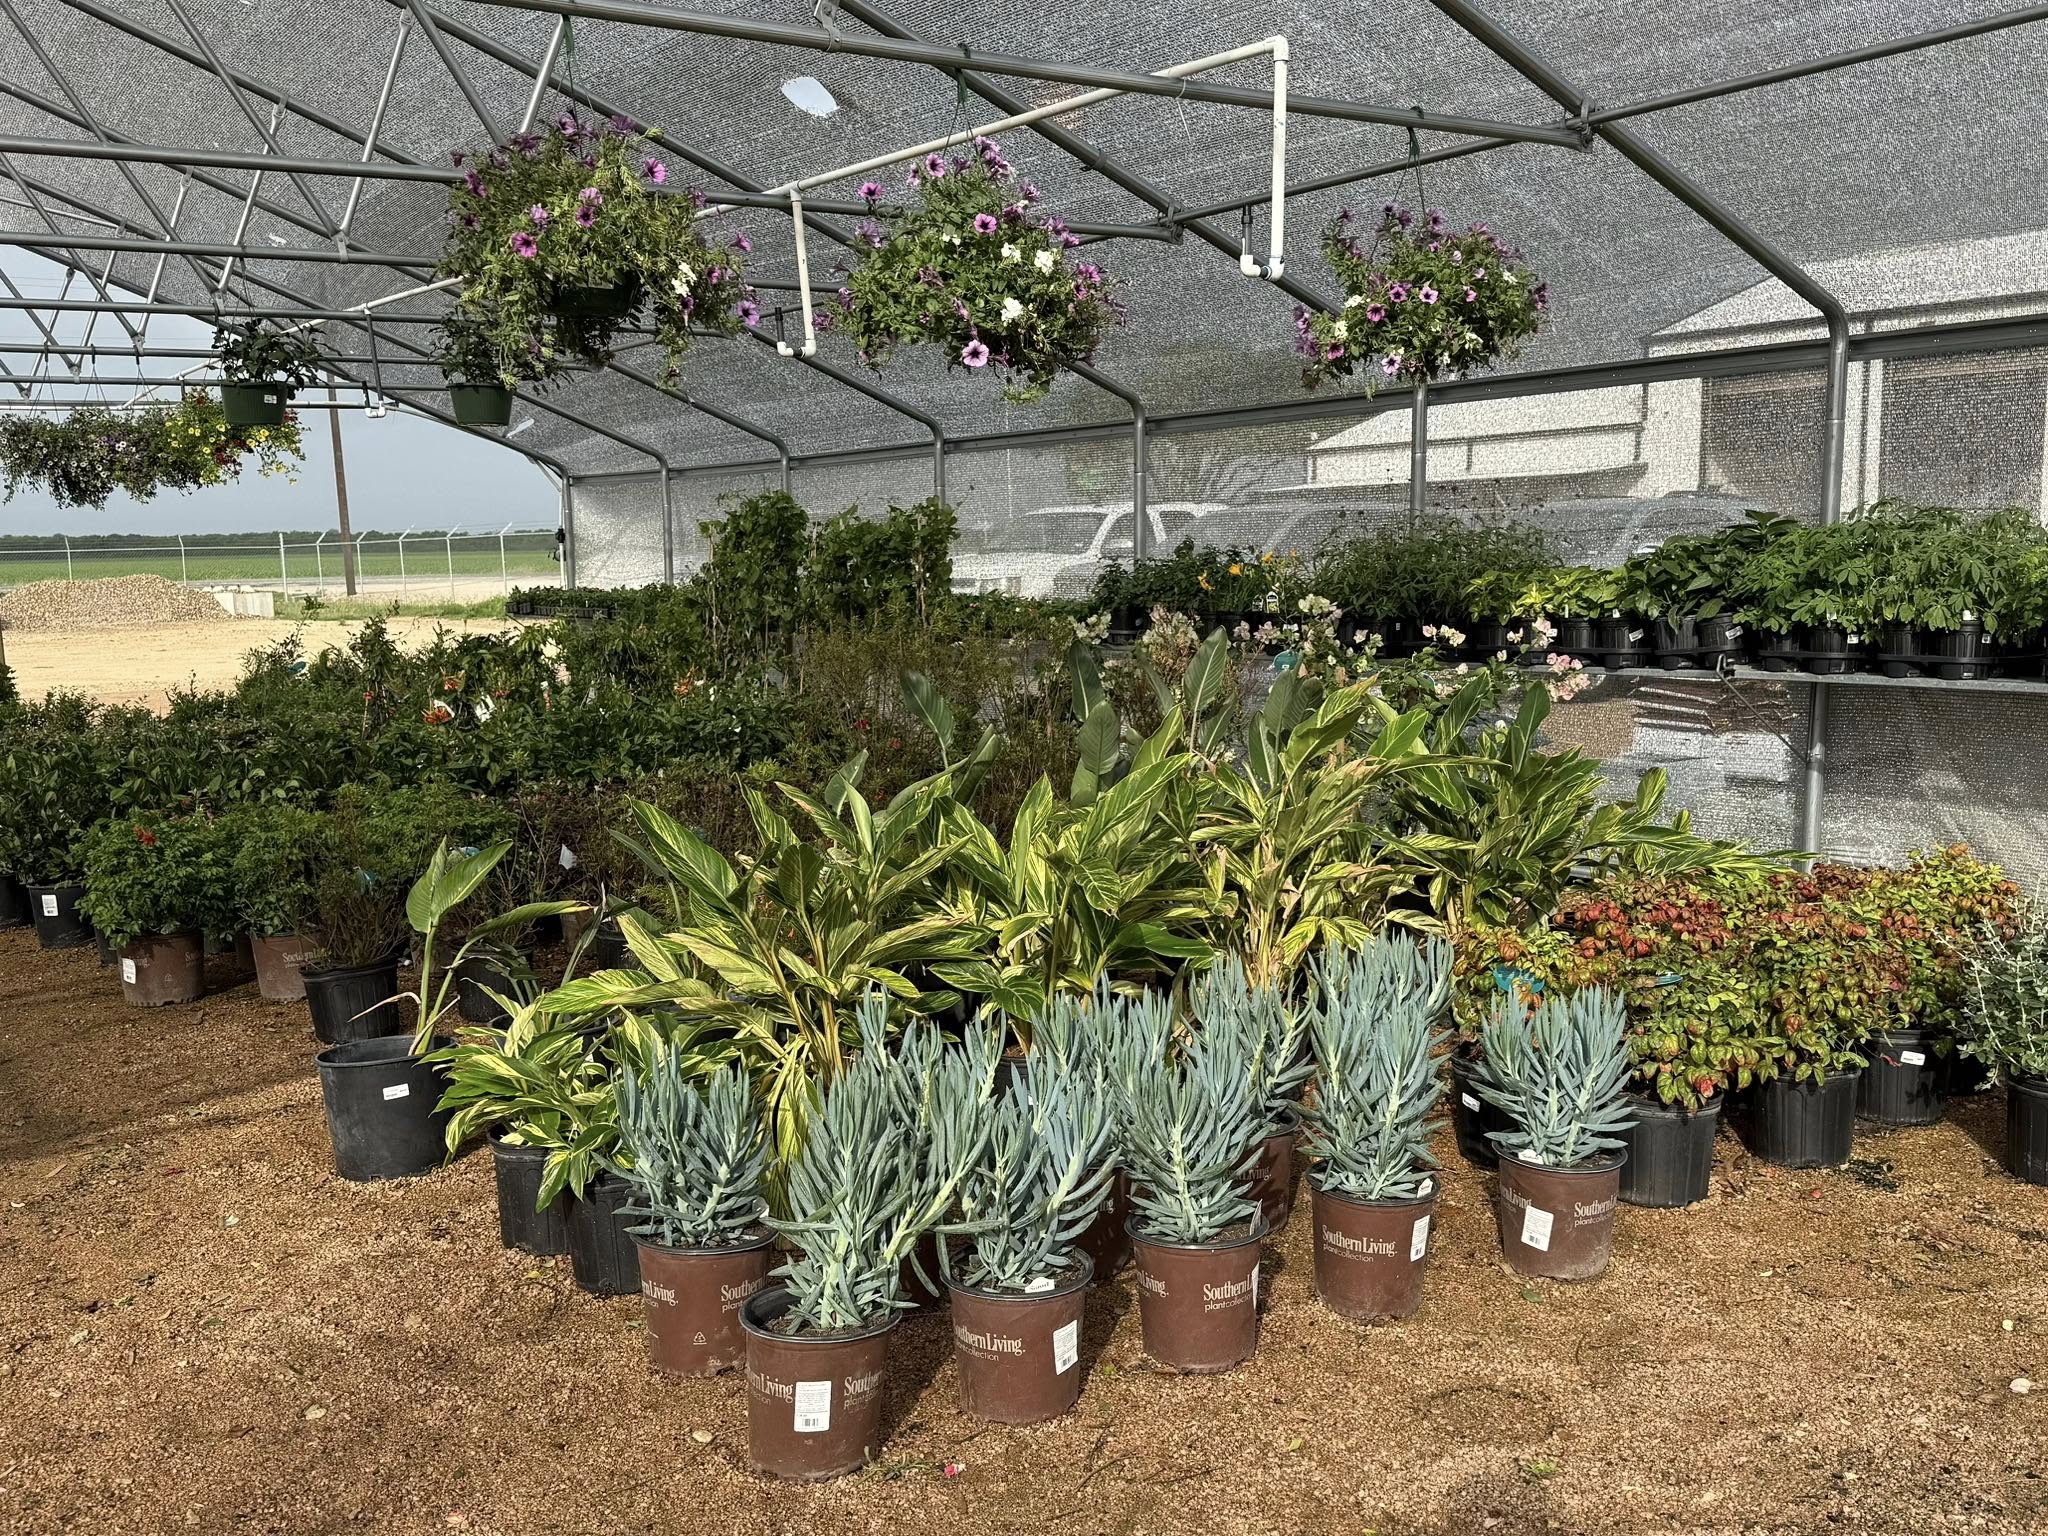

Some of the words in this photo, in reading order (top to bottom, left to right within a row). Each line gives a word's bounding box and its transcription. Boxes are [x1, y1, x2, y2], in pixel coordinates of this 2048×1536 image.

[1322, 1225, 1361, 1251] Southern
[721, 1277, 763, 1302] Southern
[1203, 1280, 1246, 1301] Southern
